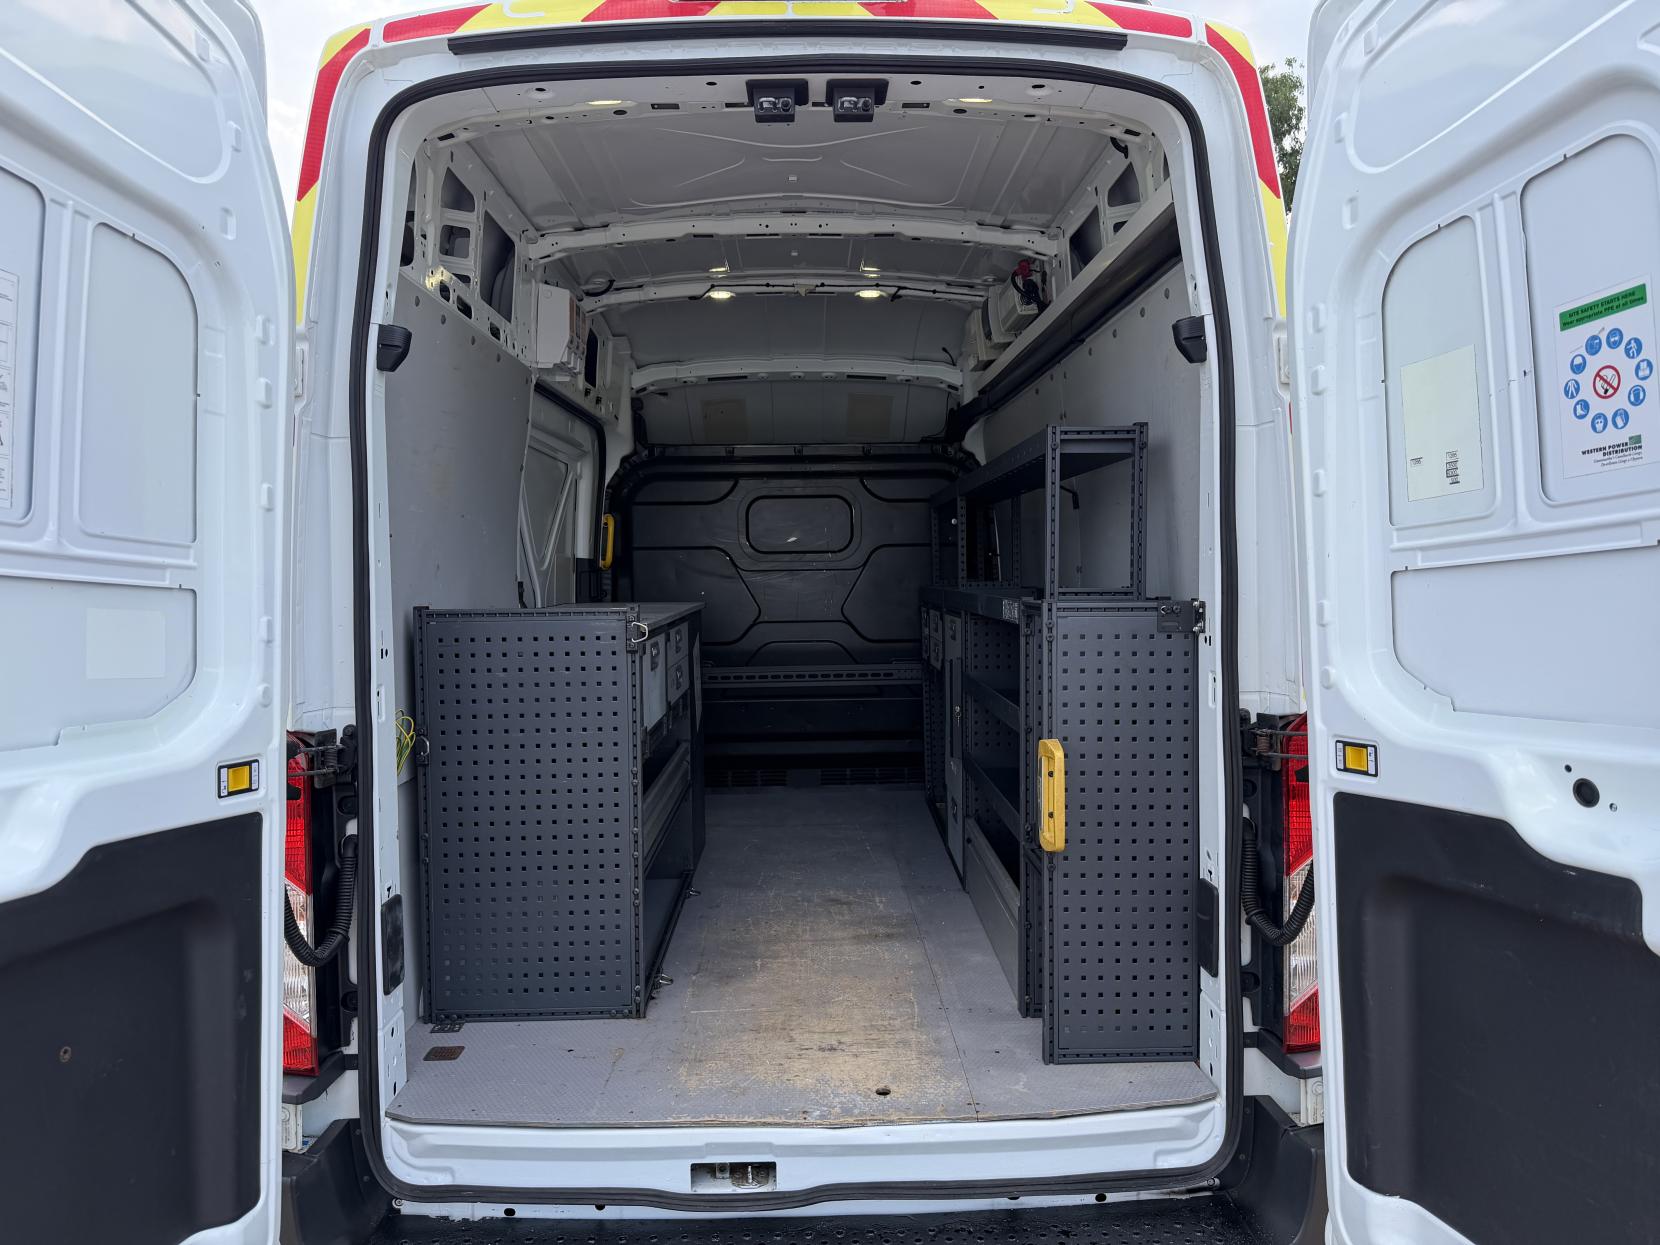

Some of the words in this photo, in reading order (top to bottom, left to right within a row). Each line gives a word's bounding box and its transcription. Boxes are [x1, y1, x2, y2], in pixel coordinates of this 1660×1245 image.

[1581, 304, 1600, 314] SAFETY
[1601, 297, 1620, 307] STARTS
[1582, 446, 1606, 455] WESTERN
[1608, 442, 1628, 450] POWER
[1603, 445, 1642, 457] DISTRIBUTION
